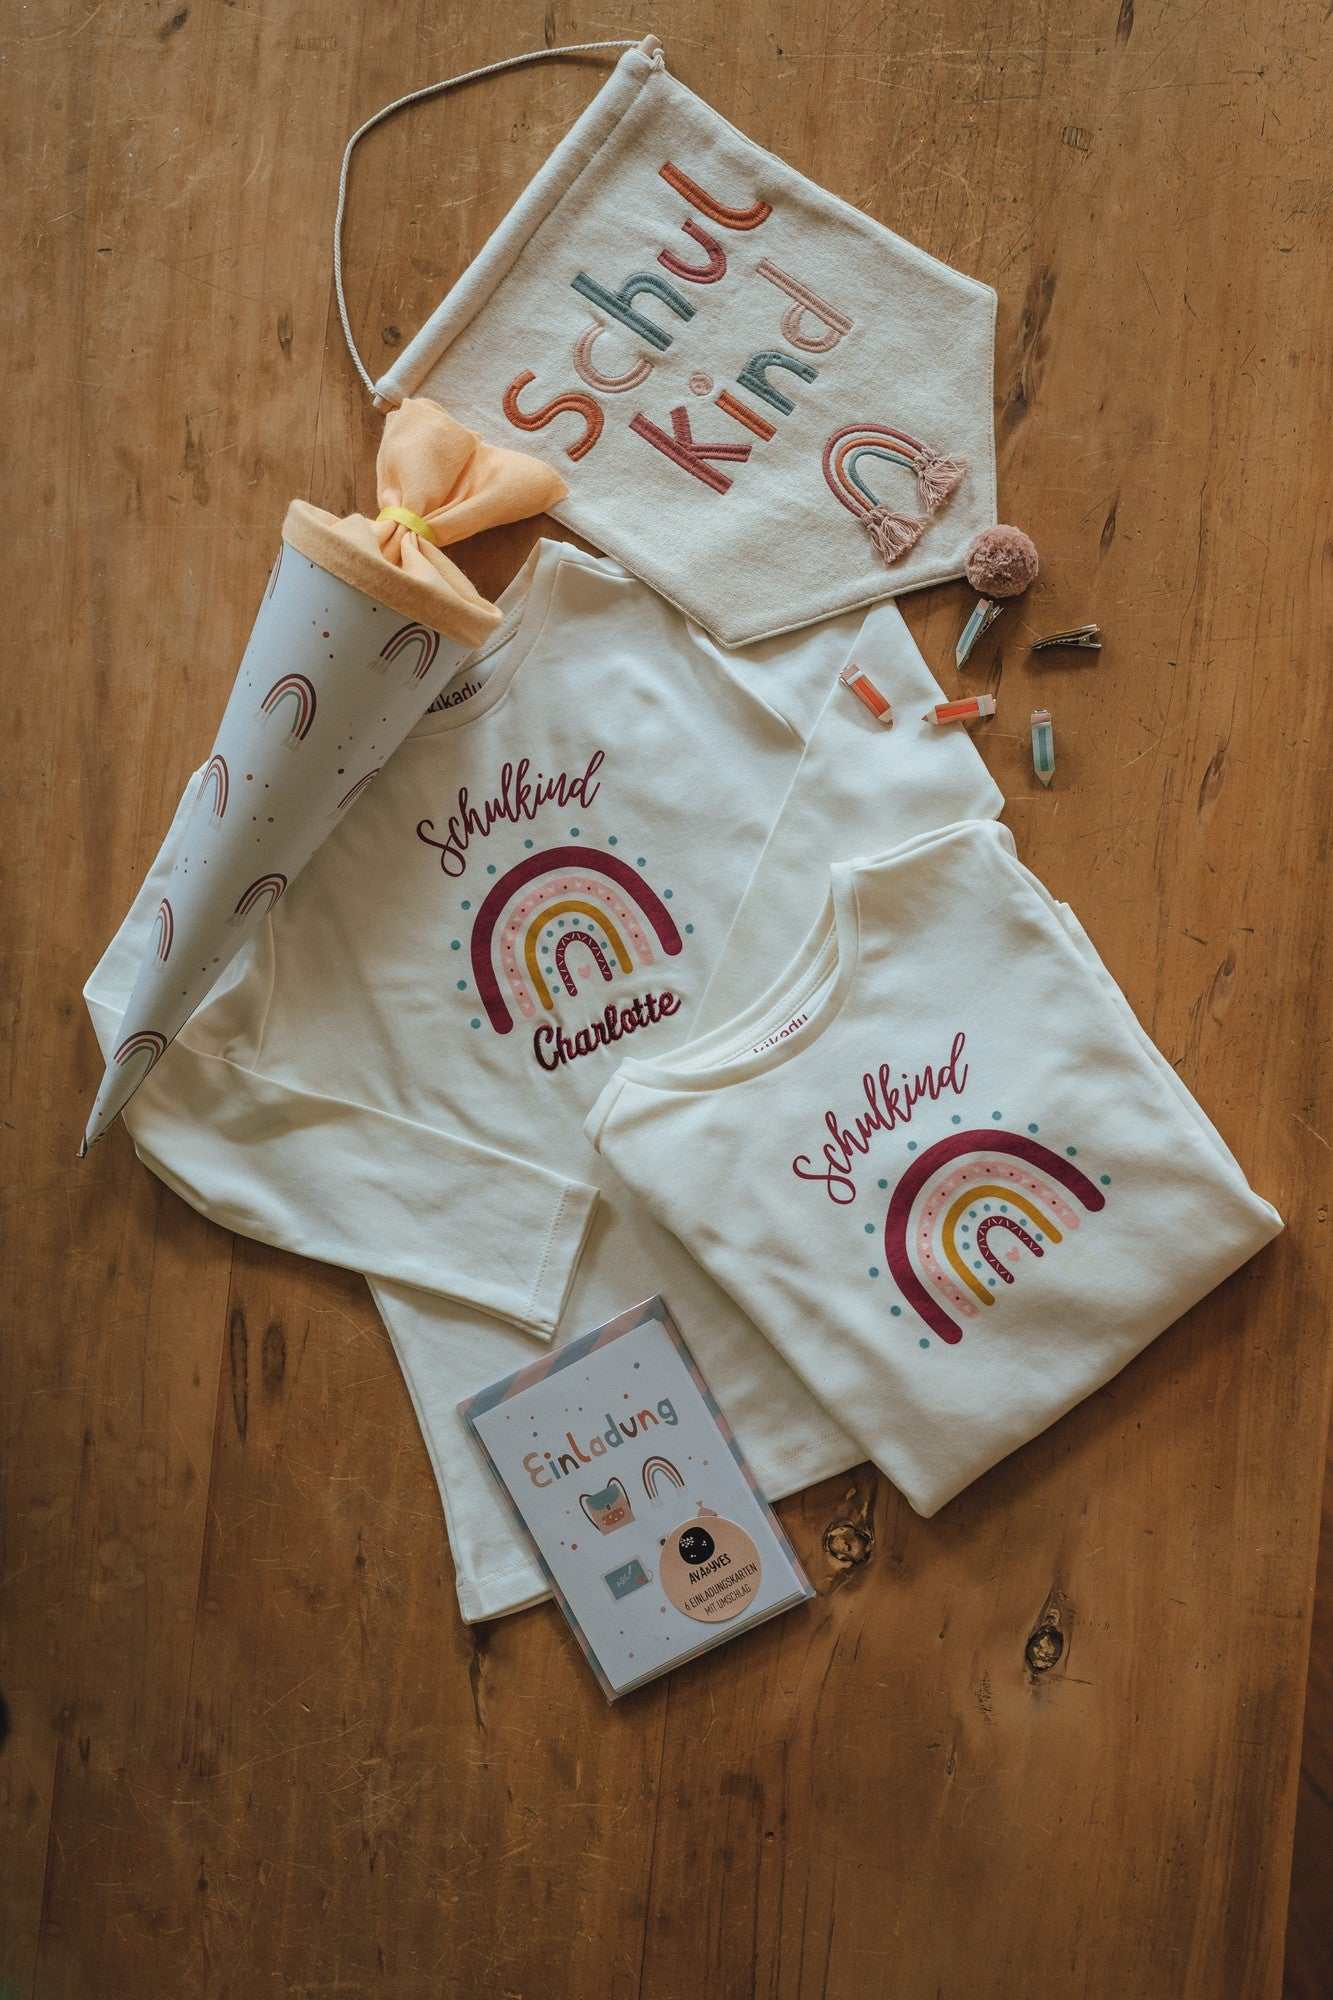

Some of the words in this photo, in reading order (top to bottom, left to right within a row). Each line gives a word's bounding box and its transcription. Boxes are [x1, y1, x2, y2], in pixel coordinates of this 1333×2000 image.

[502, 160, 773, 463] Schul
[416, 750, 605, 878] Schulkind
[532, 991, 682, 1071] Charlotte
[792, 1031, 969, 1205] Schulkind
[522, 1398, 679, 1488] Einladung
[684, 1601, 692, 1611] 6
[689, 1562, 758, 1609] EINLADUNGSKARTEN
[704, 1603, 717, 1616] MIT
[717, 1584, 752, 1610] UMSCHLAG
